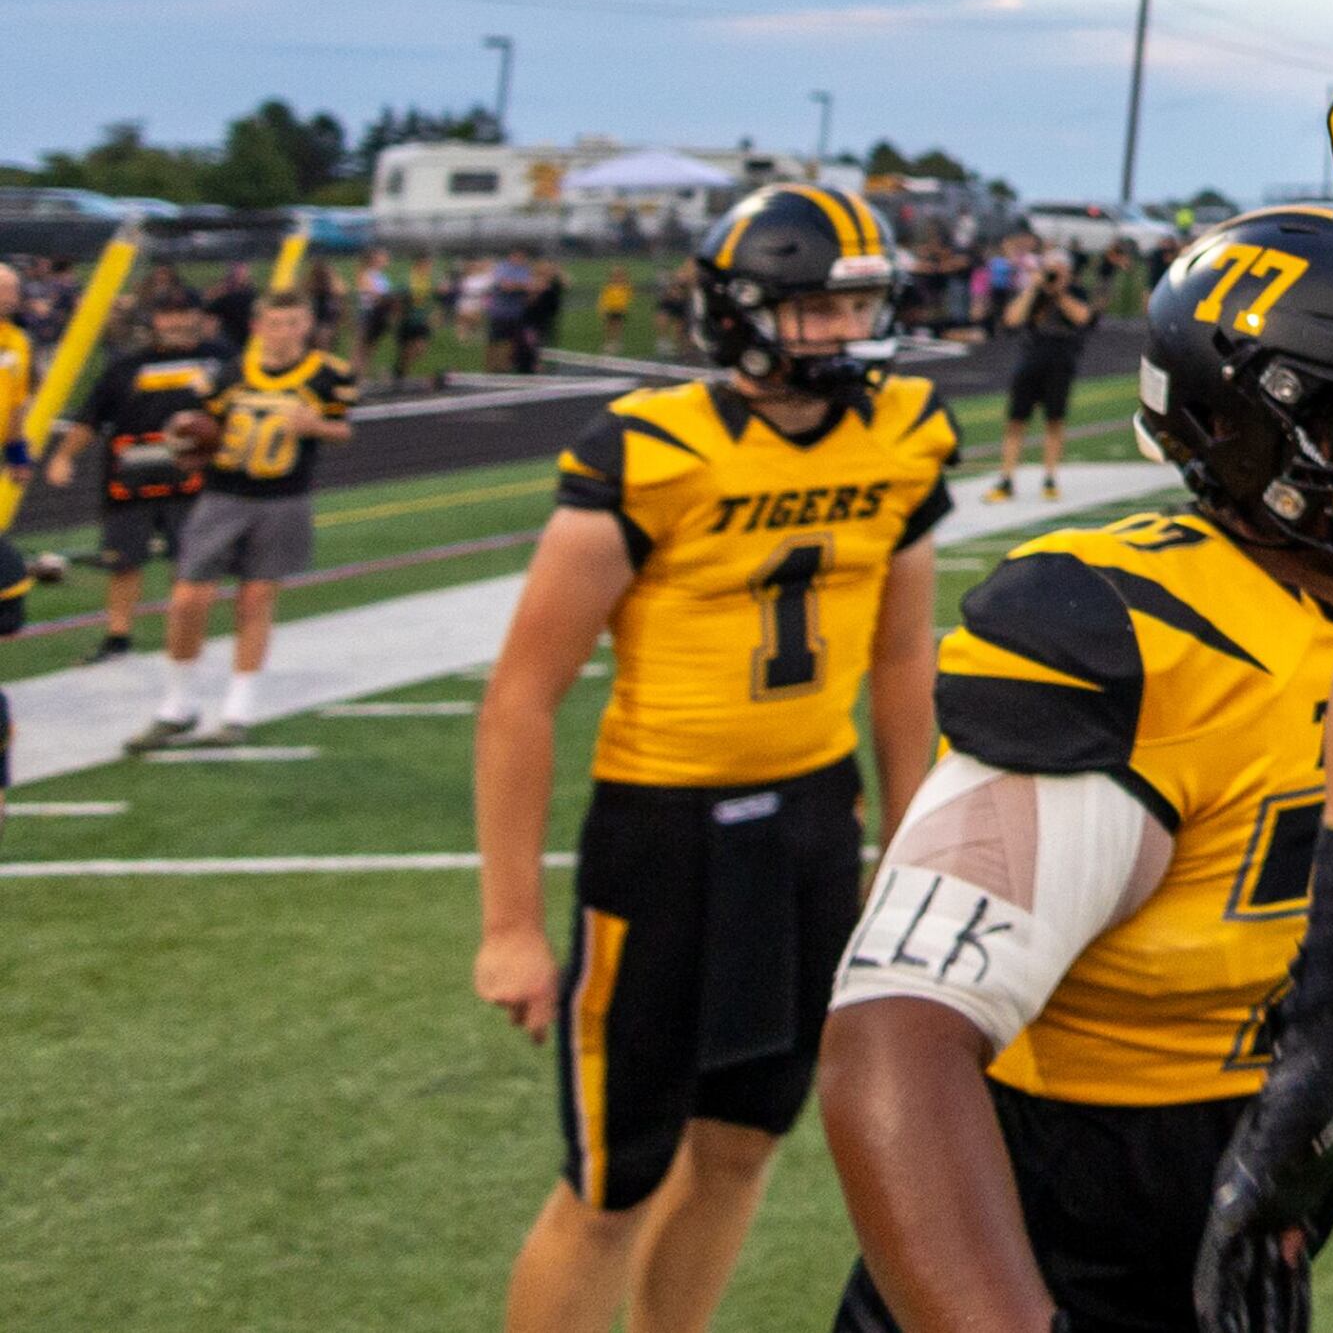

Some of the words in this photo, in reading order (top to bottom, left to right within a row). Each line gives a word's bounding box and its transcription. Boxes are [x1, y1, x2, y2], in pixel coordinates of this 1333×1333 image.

[1193, 243, 1310, 337] 77
[707, 480, 892, 533] TIGERS
[749, 531, 835, 702] 1
